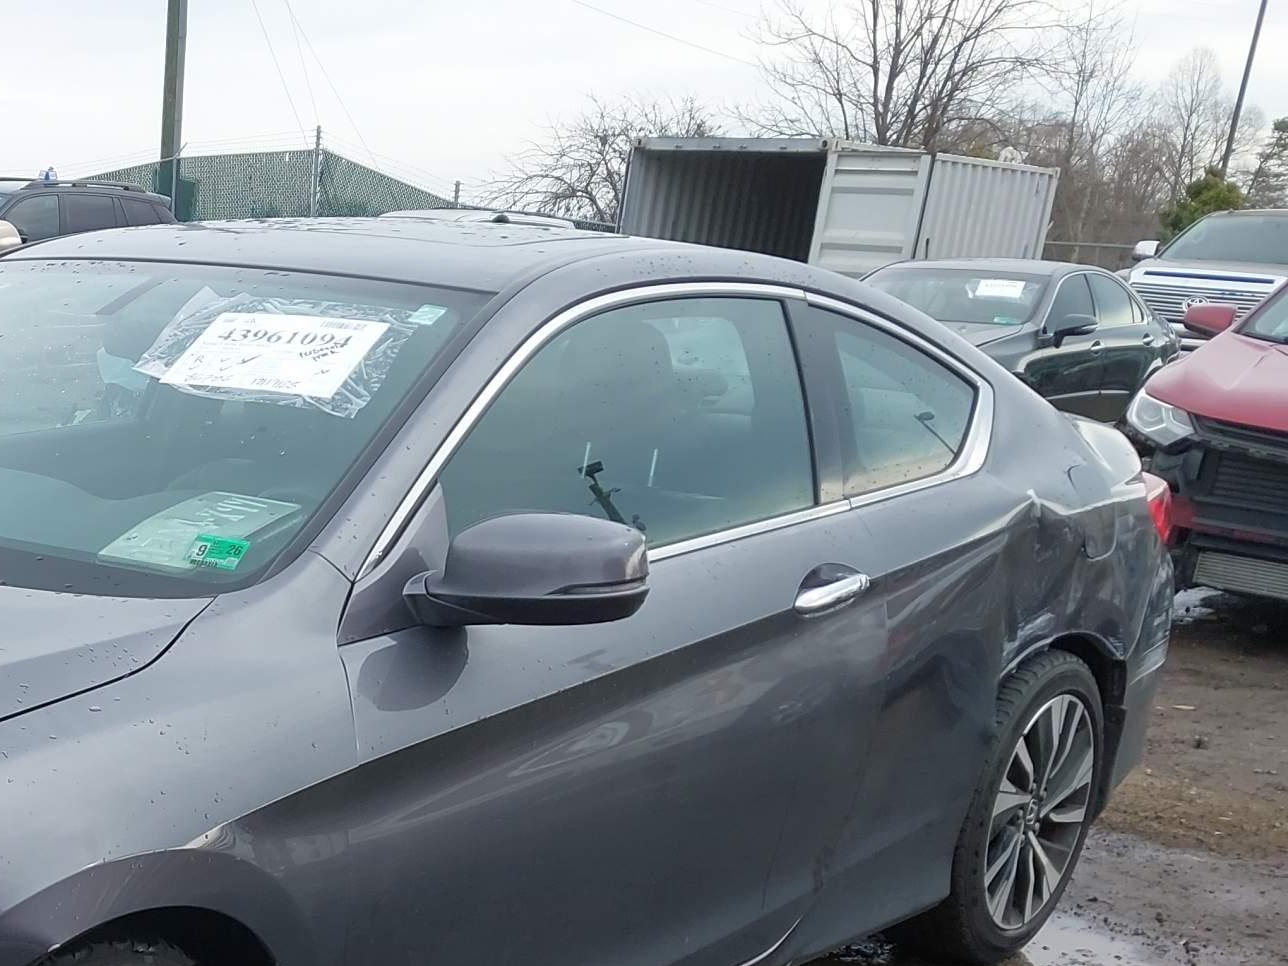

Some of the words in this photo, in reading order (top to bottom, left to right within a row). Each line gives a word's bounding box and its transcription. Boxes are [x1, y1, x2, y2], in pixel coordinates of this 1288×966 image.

[217, 327, 353, 347] 43961094
[196, 544, 208, 556] 9
[225, 544, 244, 556] 26
